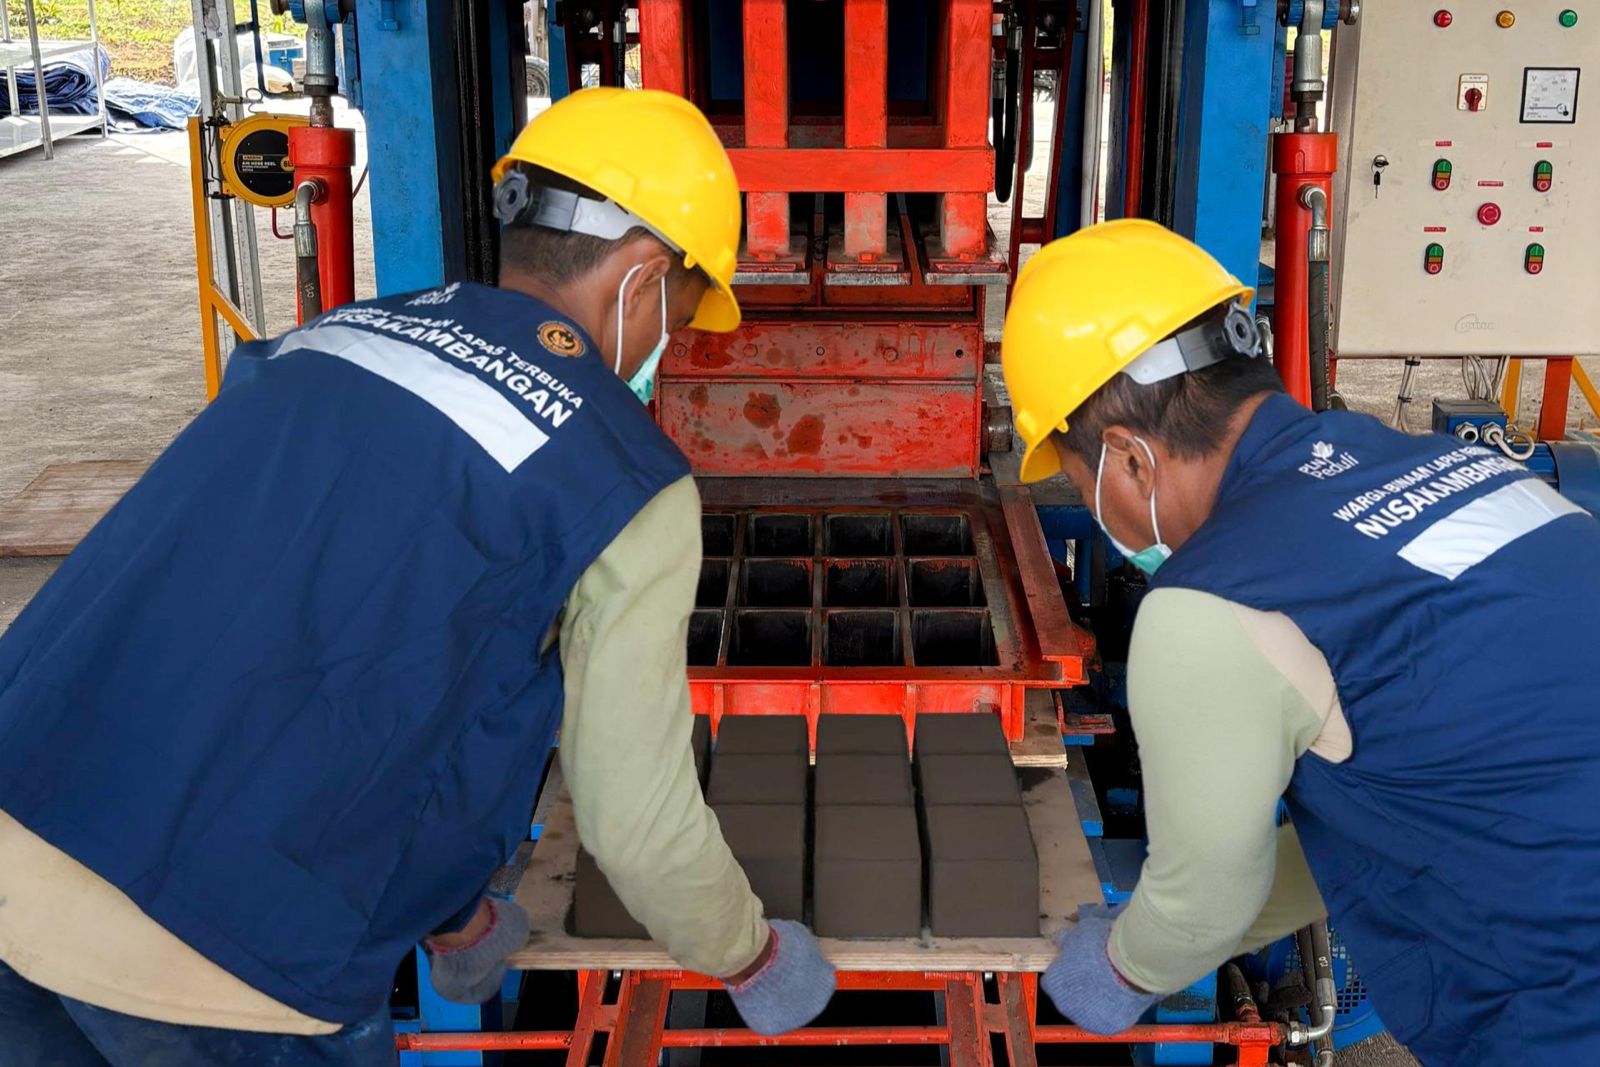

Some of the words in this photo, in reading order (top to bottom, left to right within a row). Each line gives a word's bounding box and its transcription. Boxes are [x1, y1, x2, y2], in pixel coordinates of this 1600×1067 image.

[452, 325, 507, 356] LAPAS
[507, 352, 584, 409] TERBUKA
[1298, 458, 1327, 474] PLN
[1311, 451, 1359, 480] Peduli
[1333, 489, 1390, 522] WARGA
[1382, 464, 1435, 494] BINAAN
